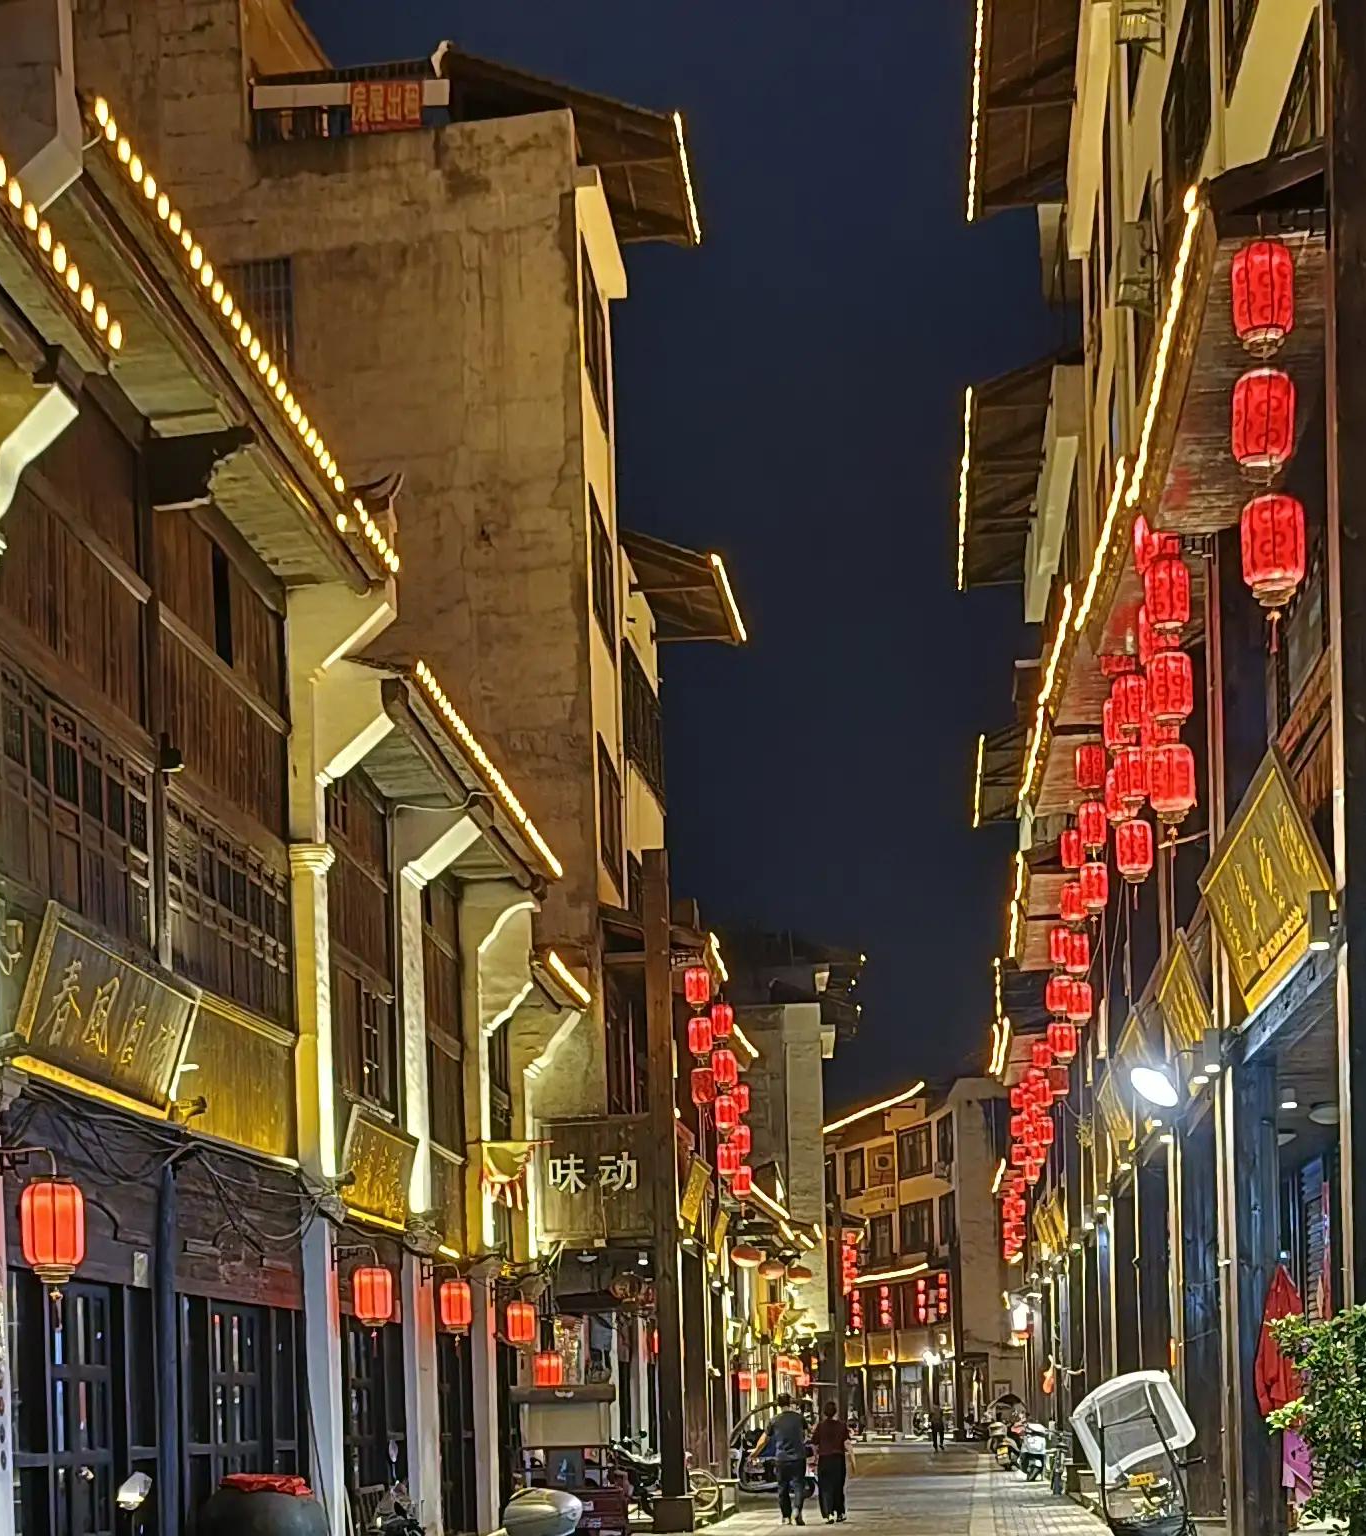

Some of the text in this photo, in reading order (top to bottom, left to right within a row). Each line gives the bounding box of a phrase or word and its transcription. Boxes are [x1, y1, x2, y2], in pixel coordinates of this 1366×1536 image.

[352, 83, 421, 123] 房屋出租
[547, 1151, 639, 1195] 味动
